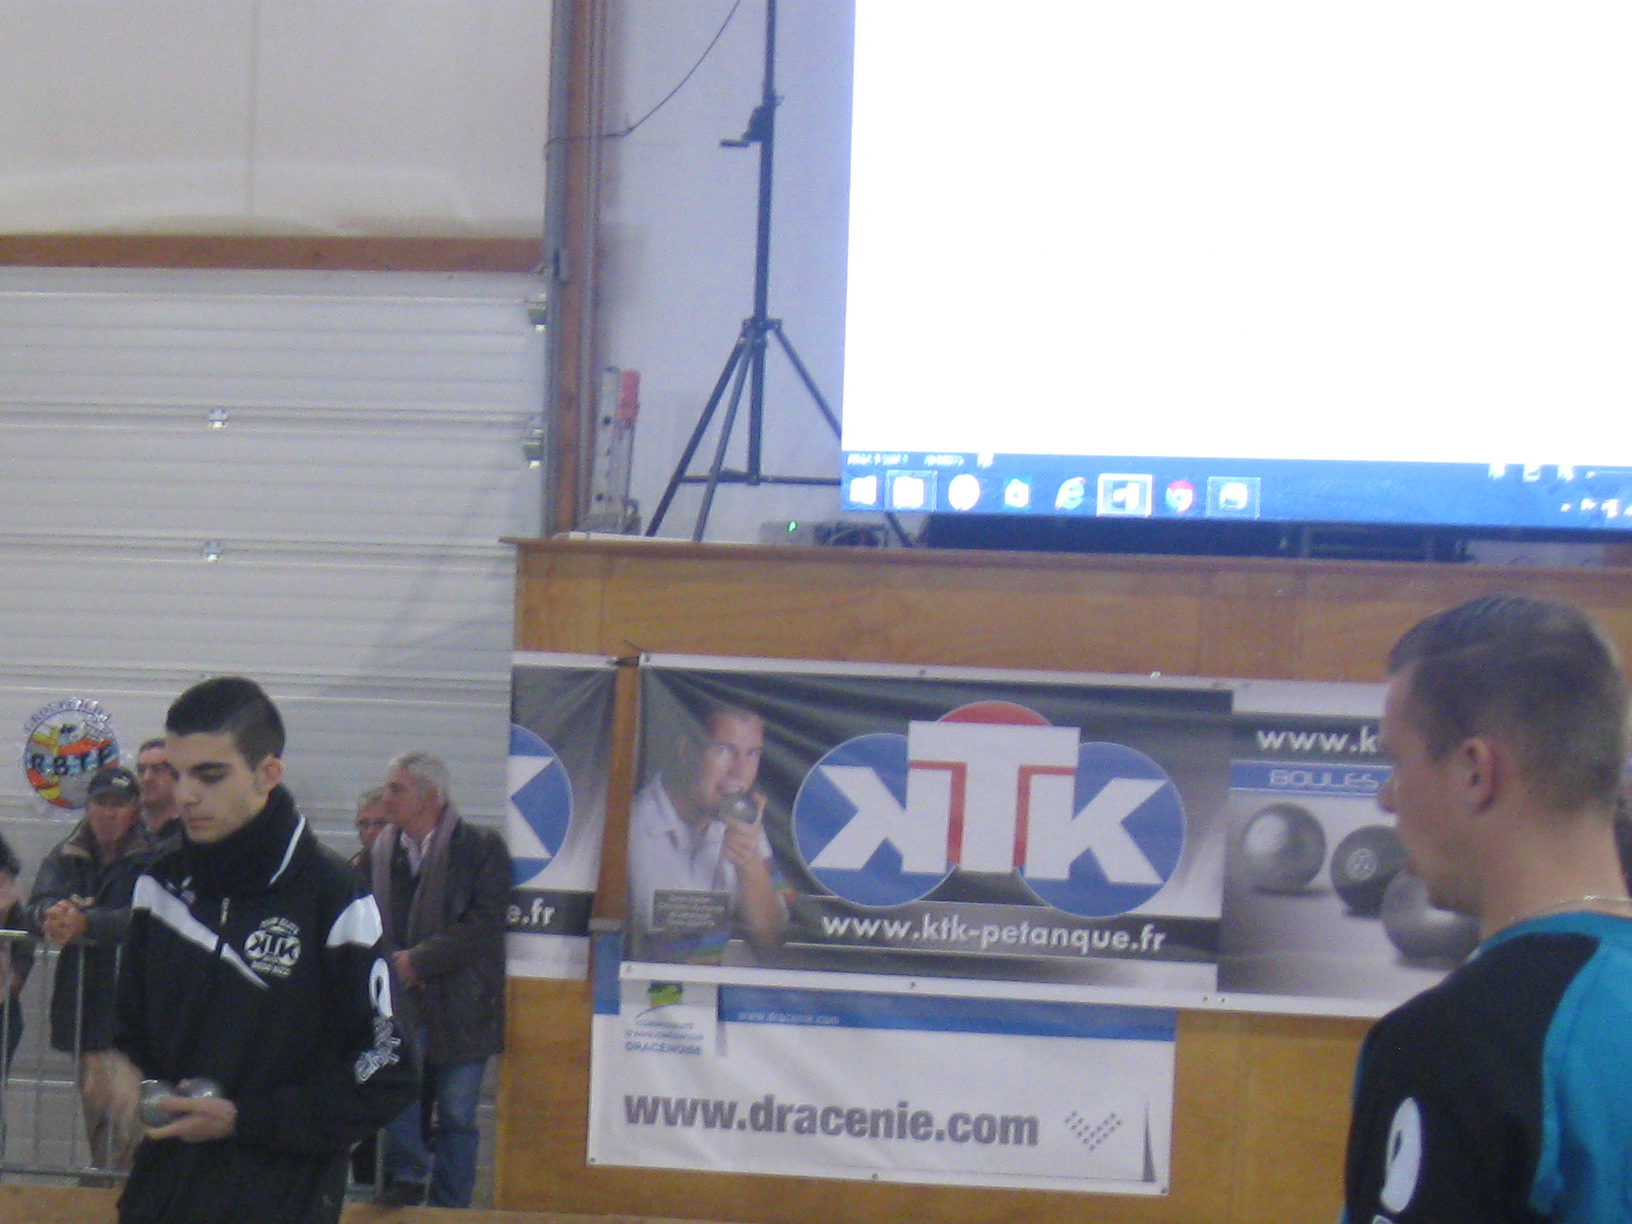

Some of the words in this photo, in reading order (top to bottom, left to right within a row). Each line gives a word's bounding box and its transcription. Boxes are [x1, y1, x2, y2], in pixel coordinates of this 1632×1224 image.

[808, 720, 1168, 886] KTK
[1270, 769, 1379, 789] BOULES
[821, 912, 1167, 955] www.ktk-petanque.fr
[624, 1093, 1039, 1147] www.dracenie.com
